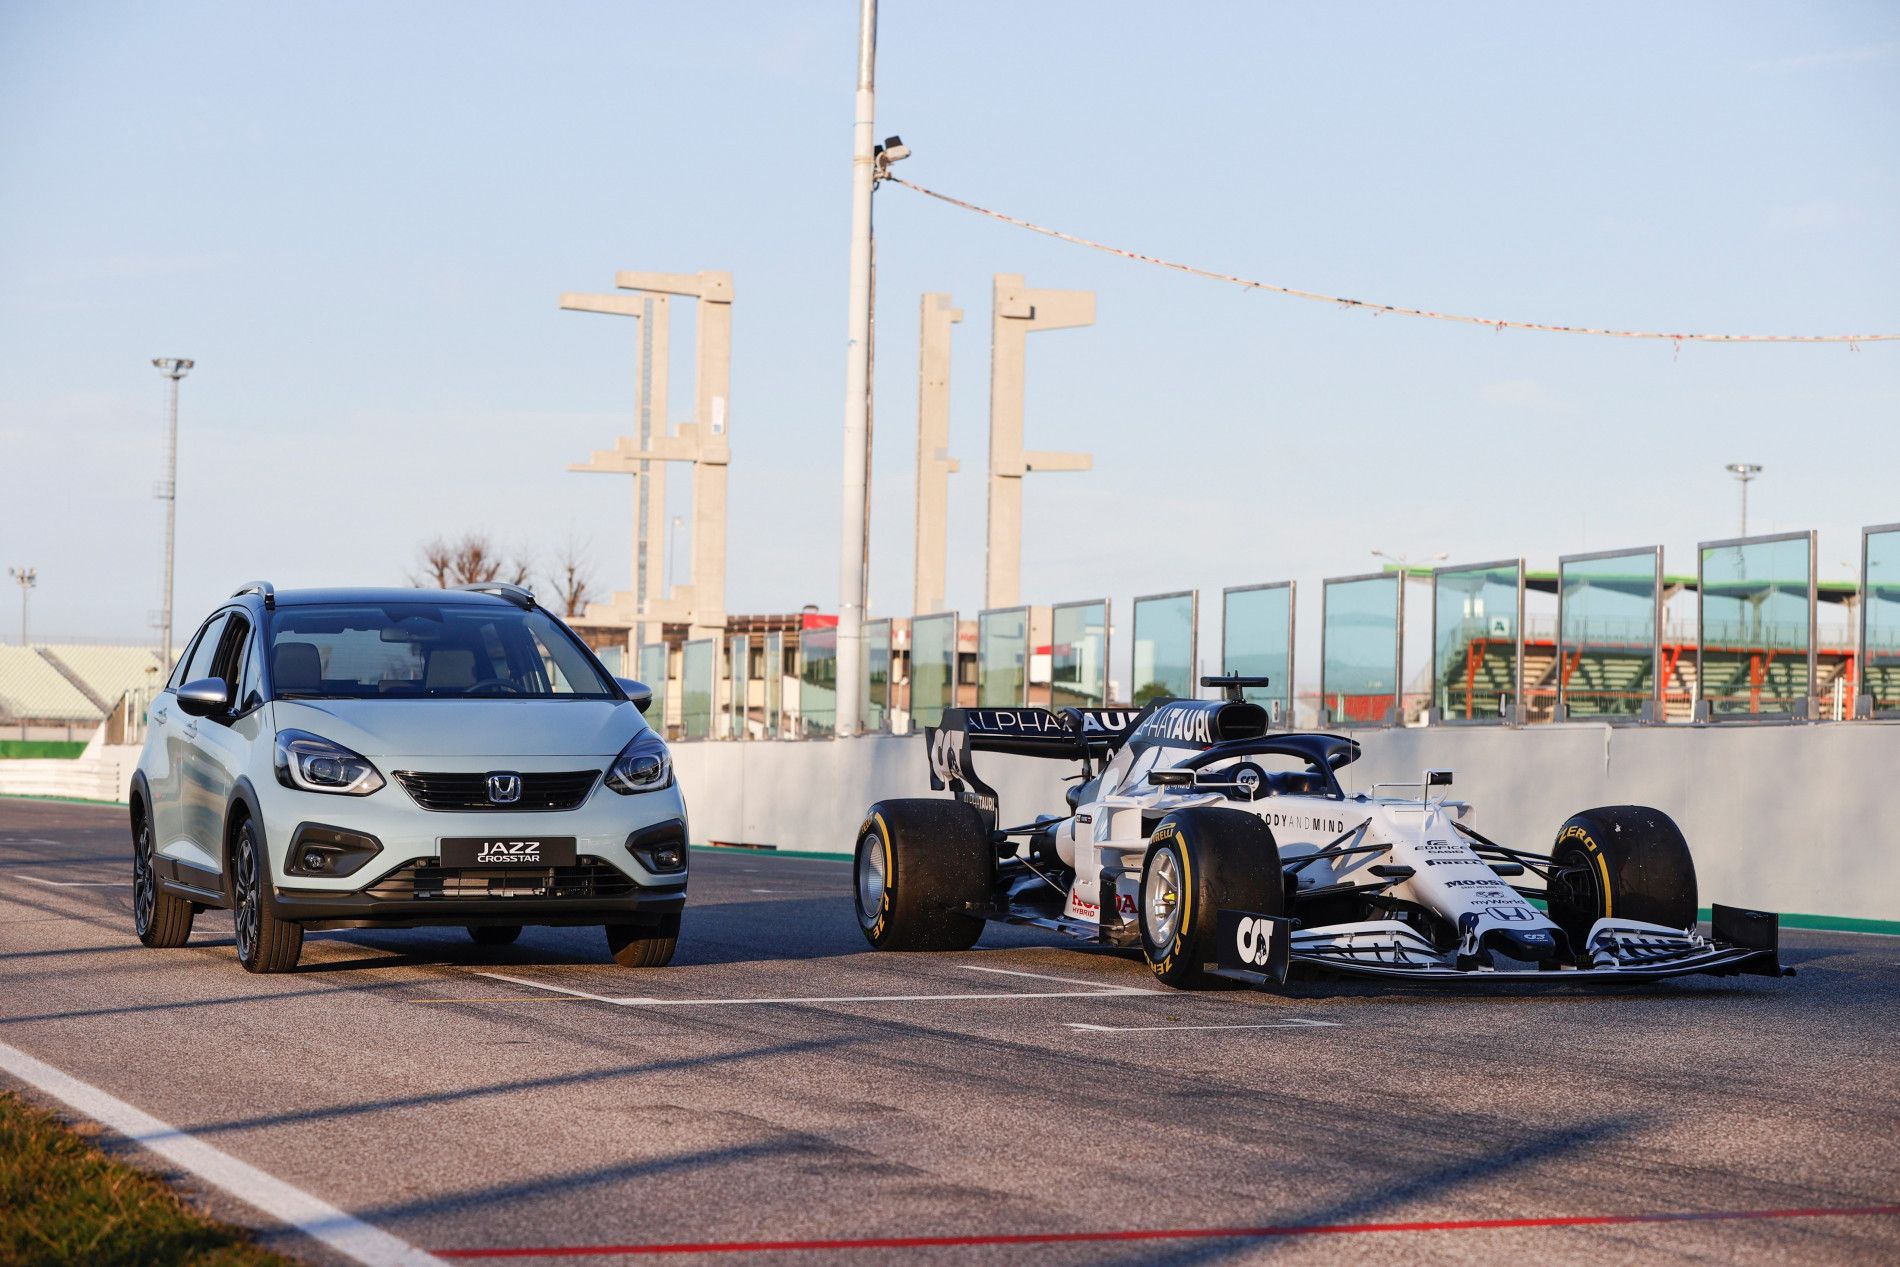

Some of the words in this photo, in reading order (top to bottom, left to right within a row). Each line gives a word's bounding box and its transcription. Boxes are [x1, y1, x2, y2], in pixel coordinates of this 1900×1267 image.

[478, 842, 540, 856] JAZZ
[477, 855, 540, 863] CROSSTAR
[1072, 906, 1096, 918] HYBRID
